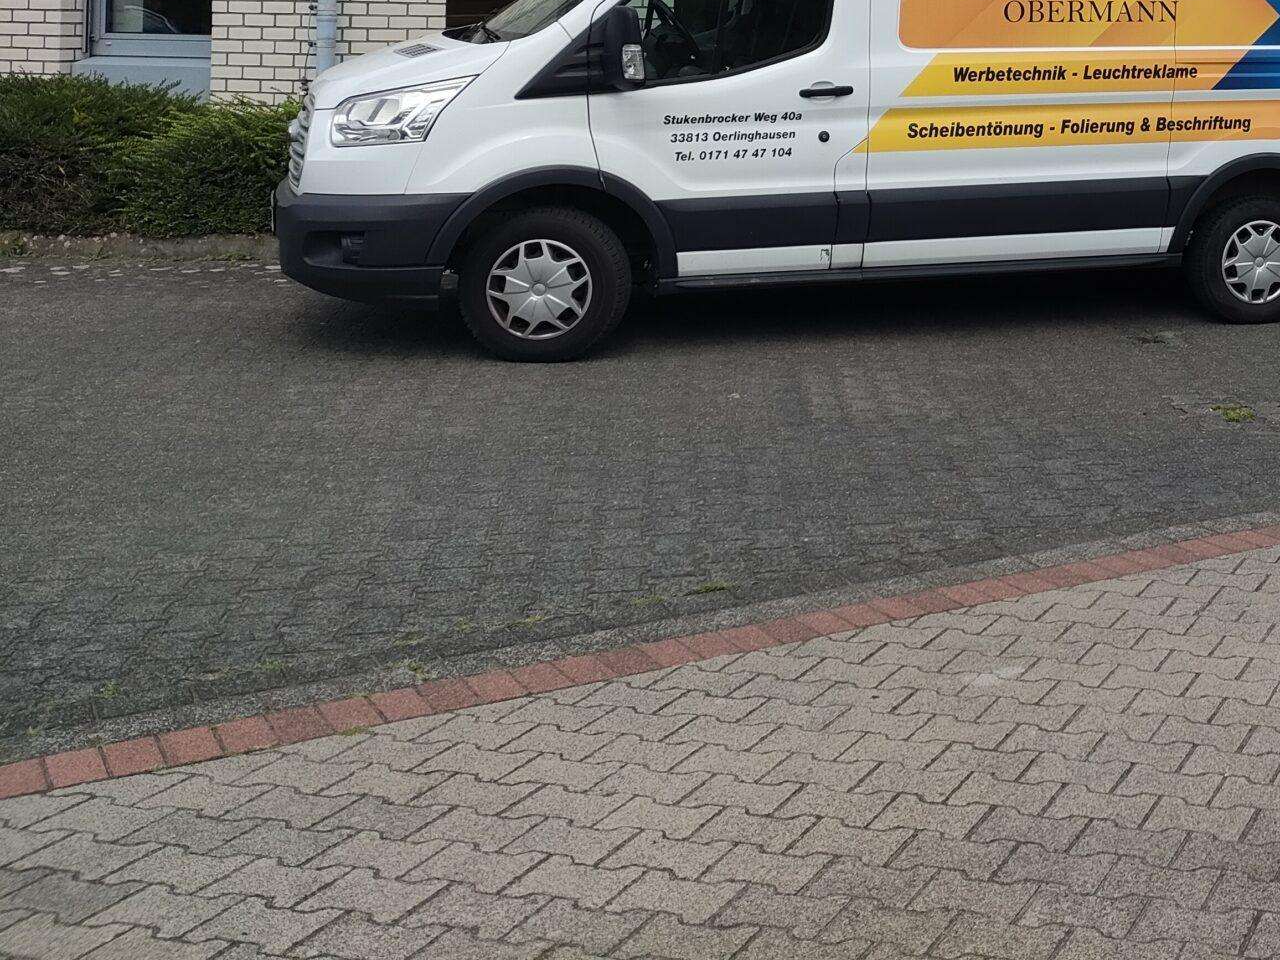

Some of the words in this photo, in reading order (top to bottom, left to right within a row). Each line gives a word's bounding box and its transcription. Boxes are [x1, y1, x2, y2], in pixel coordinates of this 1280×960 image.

[1003, 0, 1179, 23] OBERMANN
[953, 66, 1067, 82] Werbetechnik
[1083, 64, 1198, 81] Leuchtreklame
[663, 113, 750, 125] Stukenbrocker
[754, 112, 778, 123] Weg
[781, 111, 802, 121] 40a
[907, 121, 1044, 139] Scheibentönung
[1060, 118, 1135, 136] Folierung
[1140, 117, 1150, 132] &
[1156, 116, 1251, 133] Beschriftung
[670, 132, 709, 143] 33813
[712, 130, 796, 143] Oerlinghausen
[675, 151, 695, 162] Tel.
[699, 150, 729, 161] 0171
[733, 149, 749, 159] 47
[751, 148, 767, 159] 47
[771, 147, 793, 158] 104
